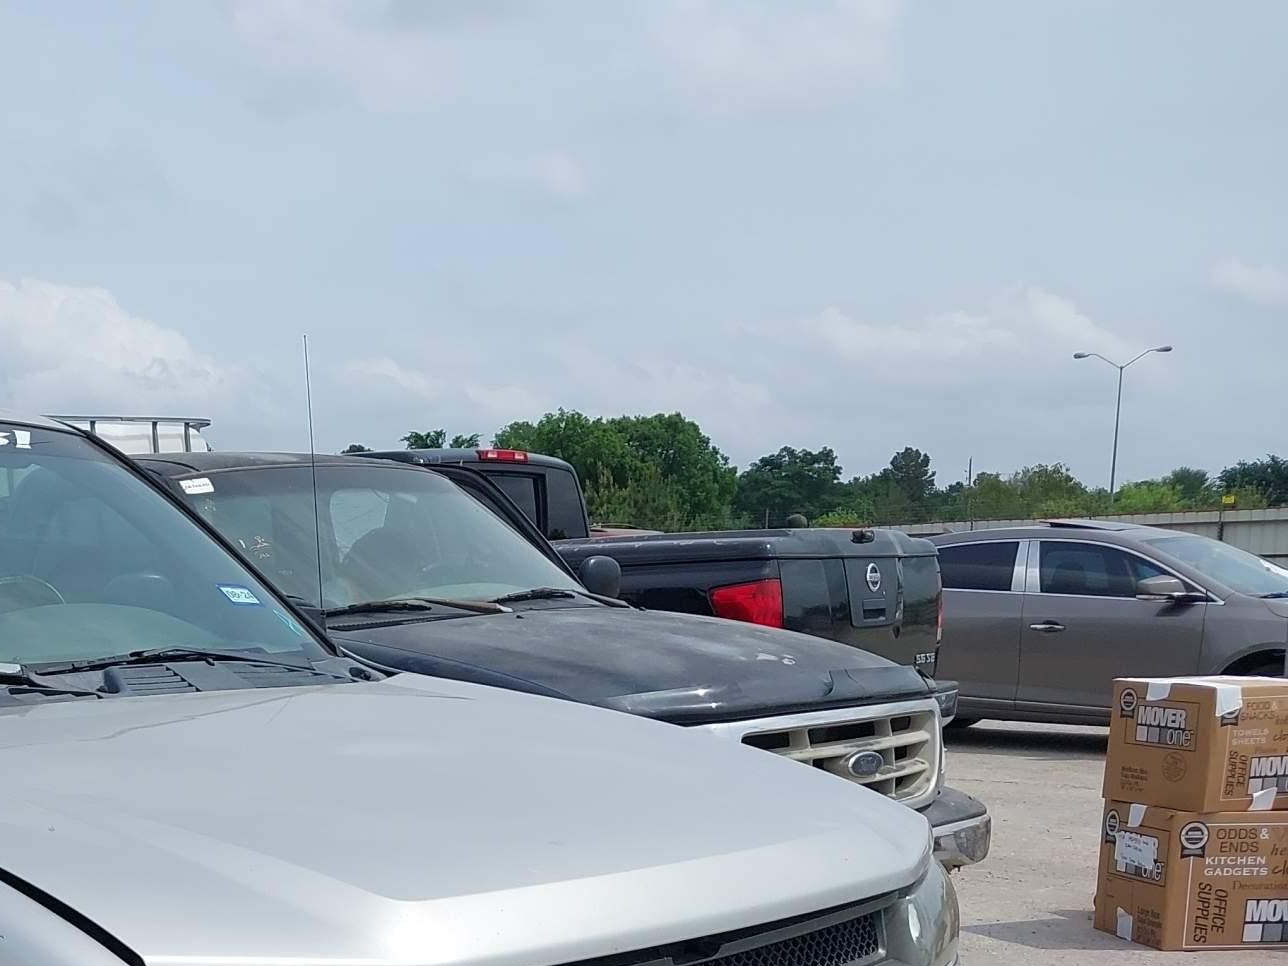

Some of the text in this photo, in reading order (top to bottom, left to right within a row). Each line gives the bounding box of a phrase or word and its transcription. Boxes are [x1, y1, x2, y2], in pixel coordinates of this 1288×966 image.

[1138, 706, 1186, 728] MOVER
[1166, 729, 1192, 746] one
[1224, 750, 1239, 797] SUPPLIES
[1236, 754, 1249, 789] OFFICE
[1216, 827, 1270, 840] ODDS &
[1219, 841, 1259, 853] ENDS
[1205, 856, 1266, 865] KITCHEN
[1204, 867, 1268, 876] GADGETS
[1193, 882, 1213, 943] SUPPLIES
[1211, 888, 1229, 933] OFFICE
